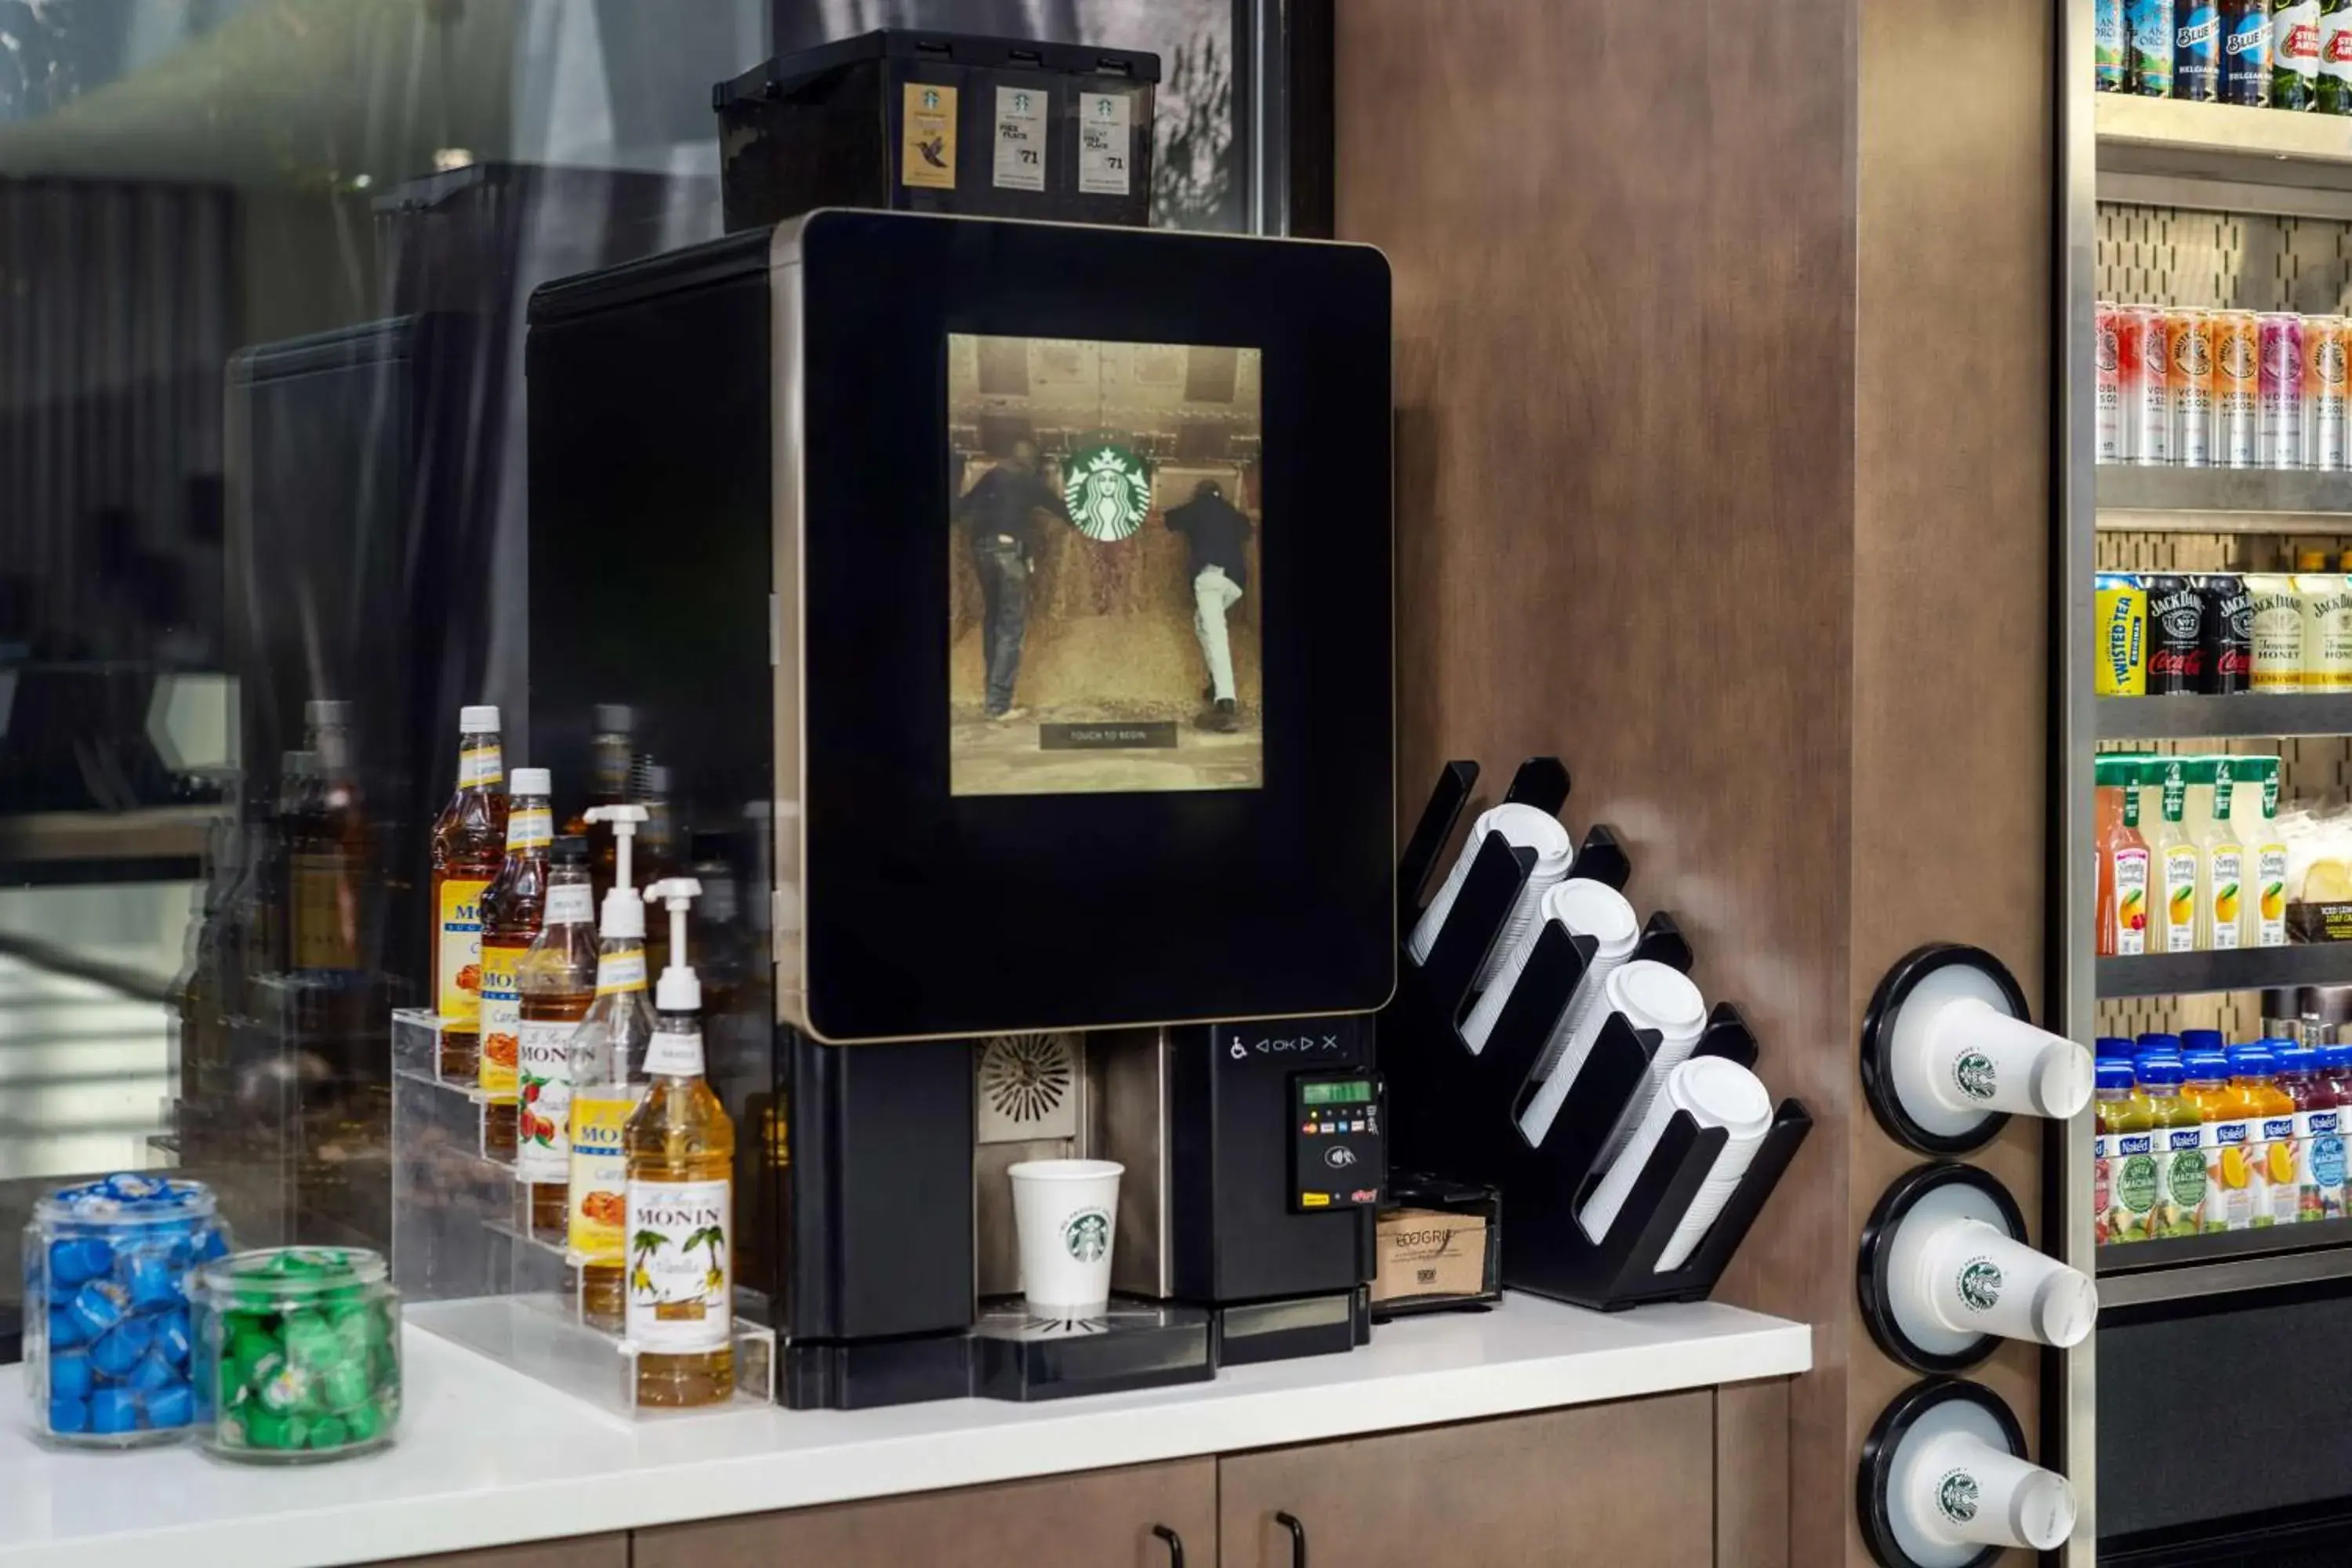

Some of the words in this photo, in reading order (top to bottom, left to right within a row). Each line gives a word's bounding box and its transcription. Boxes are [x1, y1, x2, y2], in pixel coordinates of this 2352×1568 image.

[2114, 597, 2132, 622] TEA
[2150, 593, 2180, 617] JACK
[2111, 625, 2132, 686] TWISTED
[637, 1207, 719, 1225] MONIN
